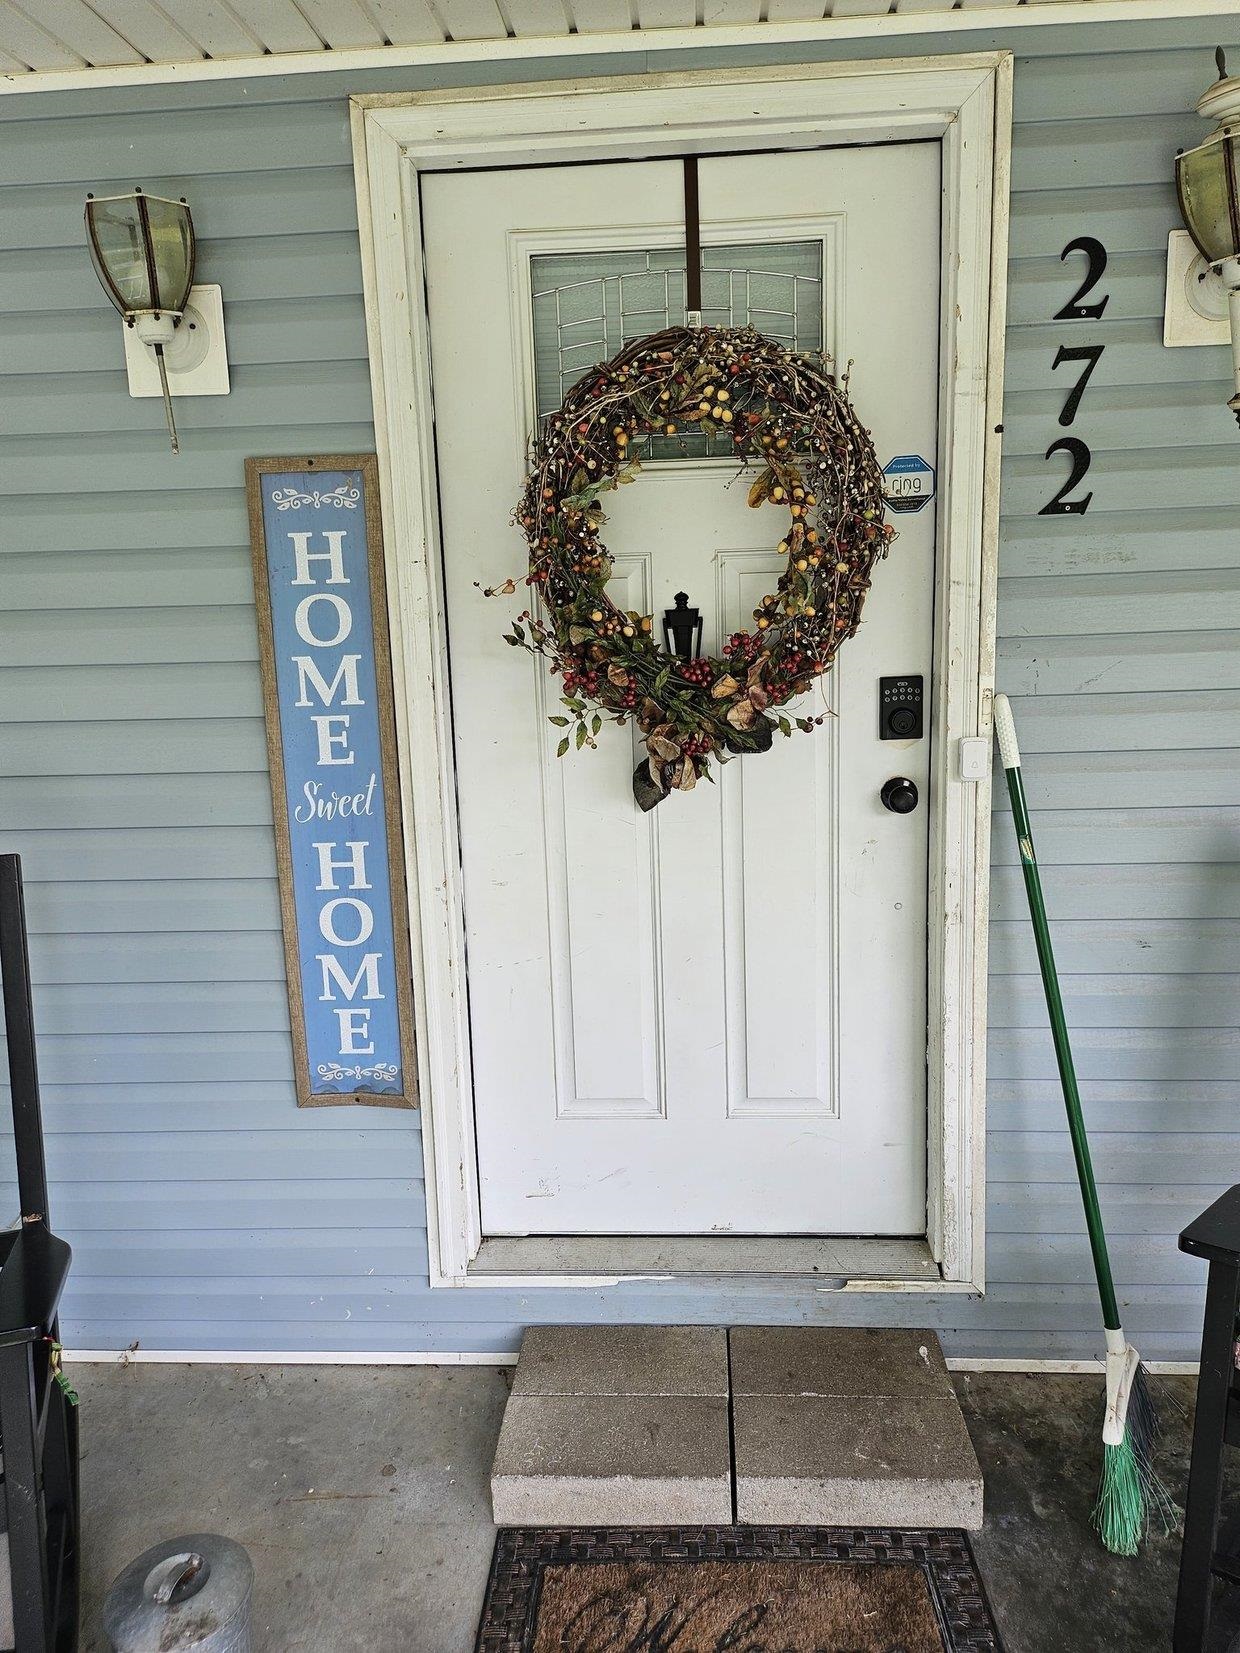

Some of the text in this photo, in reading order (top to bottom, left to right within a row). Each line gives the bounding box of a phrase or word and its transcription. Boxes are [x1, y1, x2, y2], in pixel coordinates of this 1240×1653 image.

[892, 476, 921, 493] ring
[287, 531, 364, 765] HOME
[295, 773, 376, 821] Sweet
[313, 842, 384, 1055] HOME
